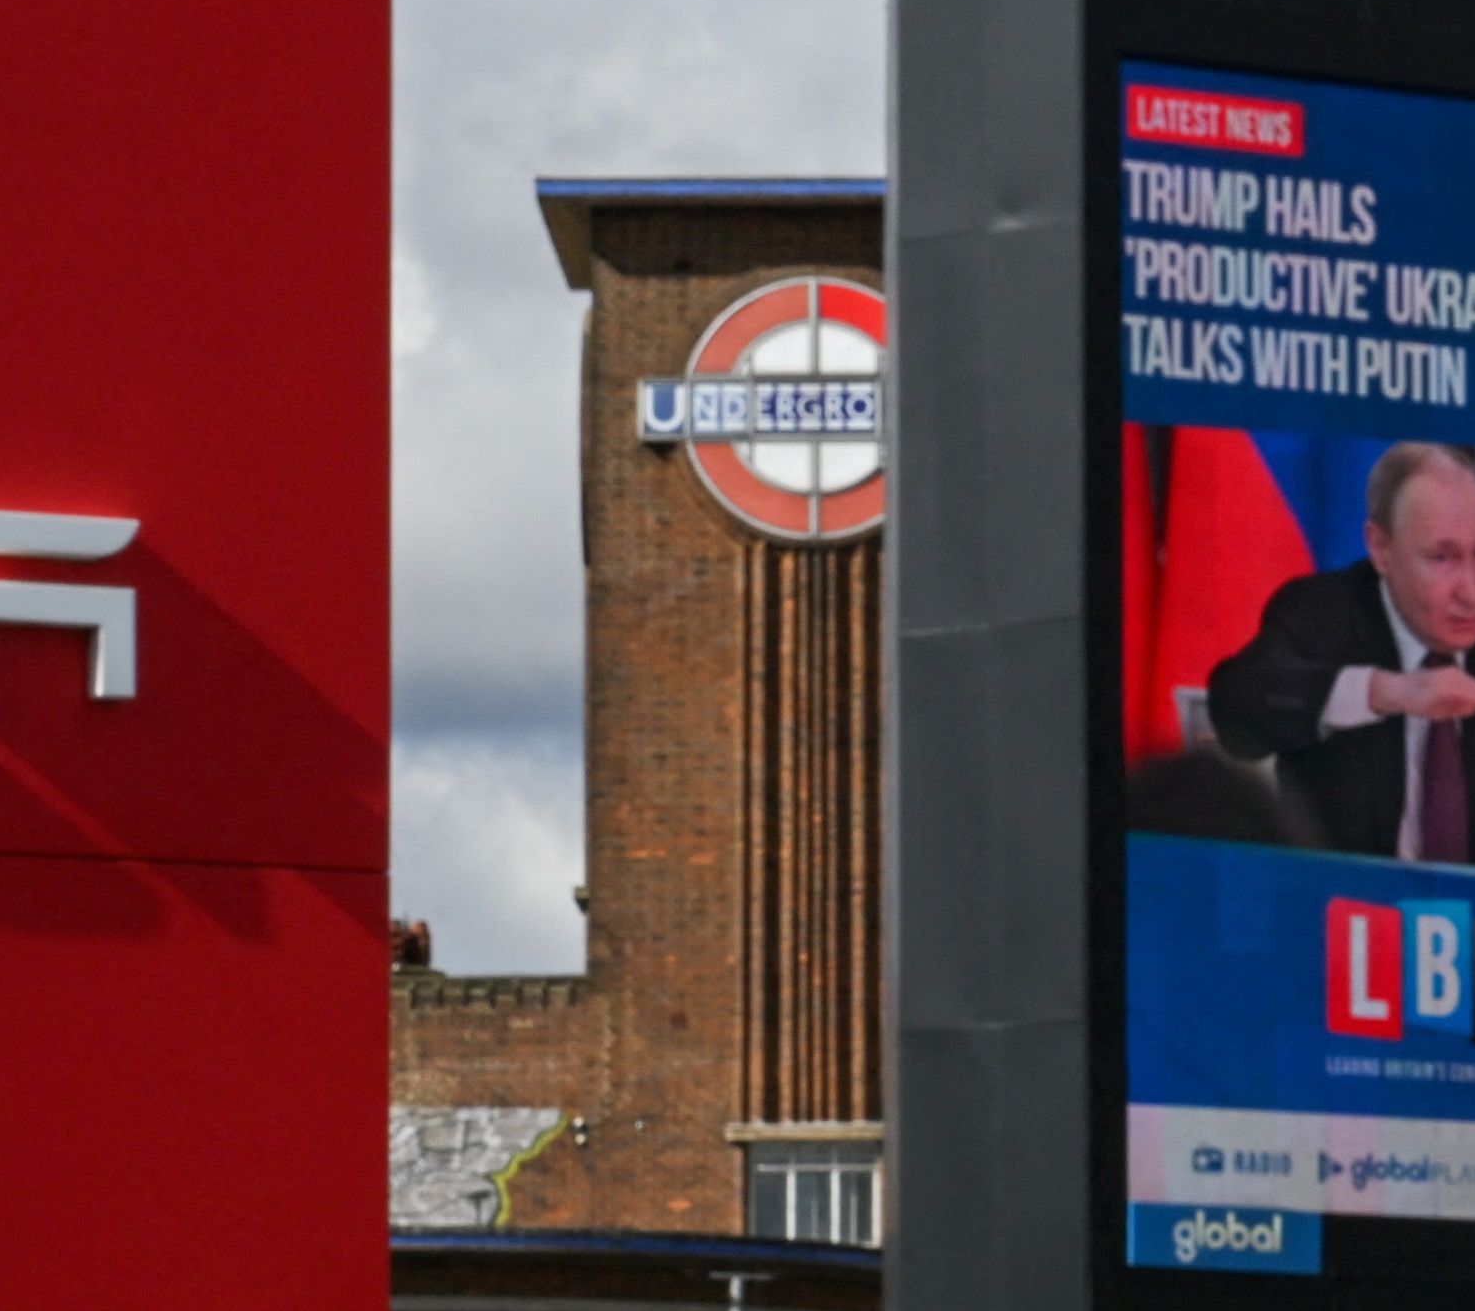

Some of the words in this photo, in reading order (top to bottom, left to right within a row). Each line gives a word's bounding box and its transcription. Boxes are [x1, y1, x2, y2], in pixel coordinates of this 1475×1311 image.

[1136, 94, 1220, 139] LATEST
[1225, 108, 1292, 148] NEWS
[1123, 158, 1258, 233] TRUMP
[1265, 174, 1377, 246] HAILS
[1123, 235, 1378, 322] 'PRODUCTIVE'
[1123, 313, 1245, 385] TALKS
[1251, 325, 1348, 397] WITH
[1356, 336, 1468, 409] PUTIN
[1174, 1208, 1283, 1264] global
